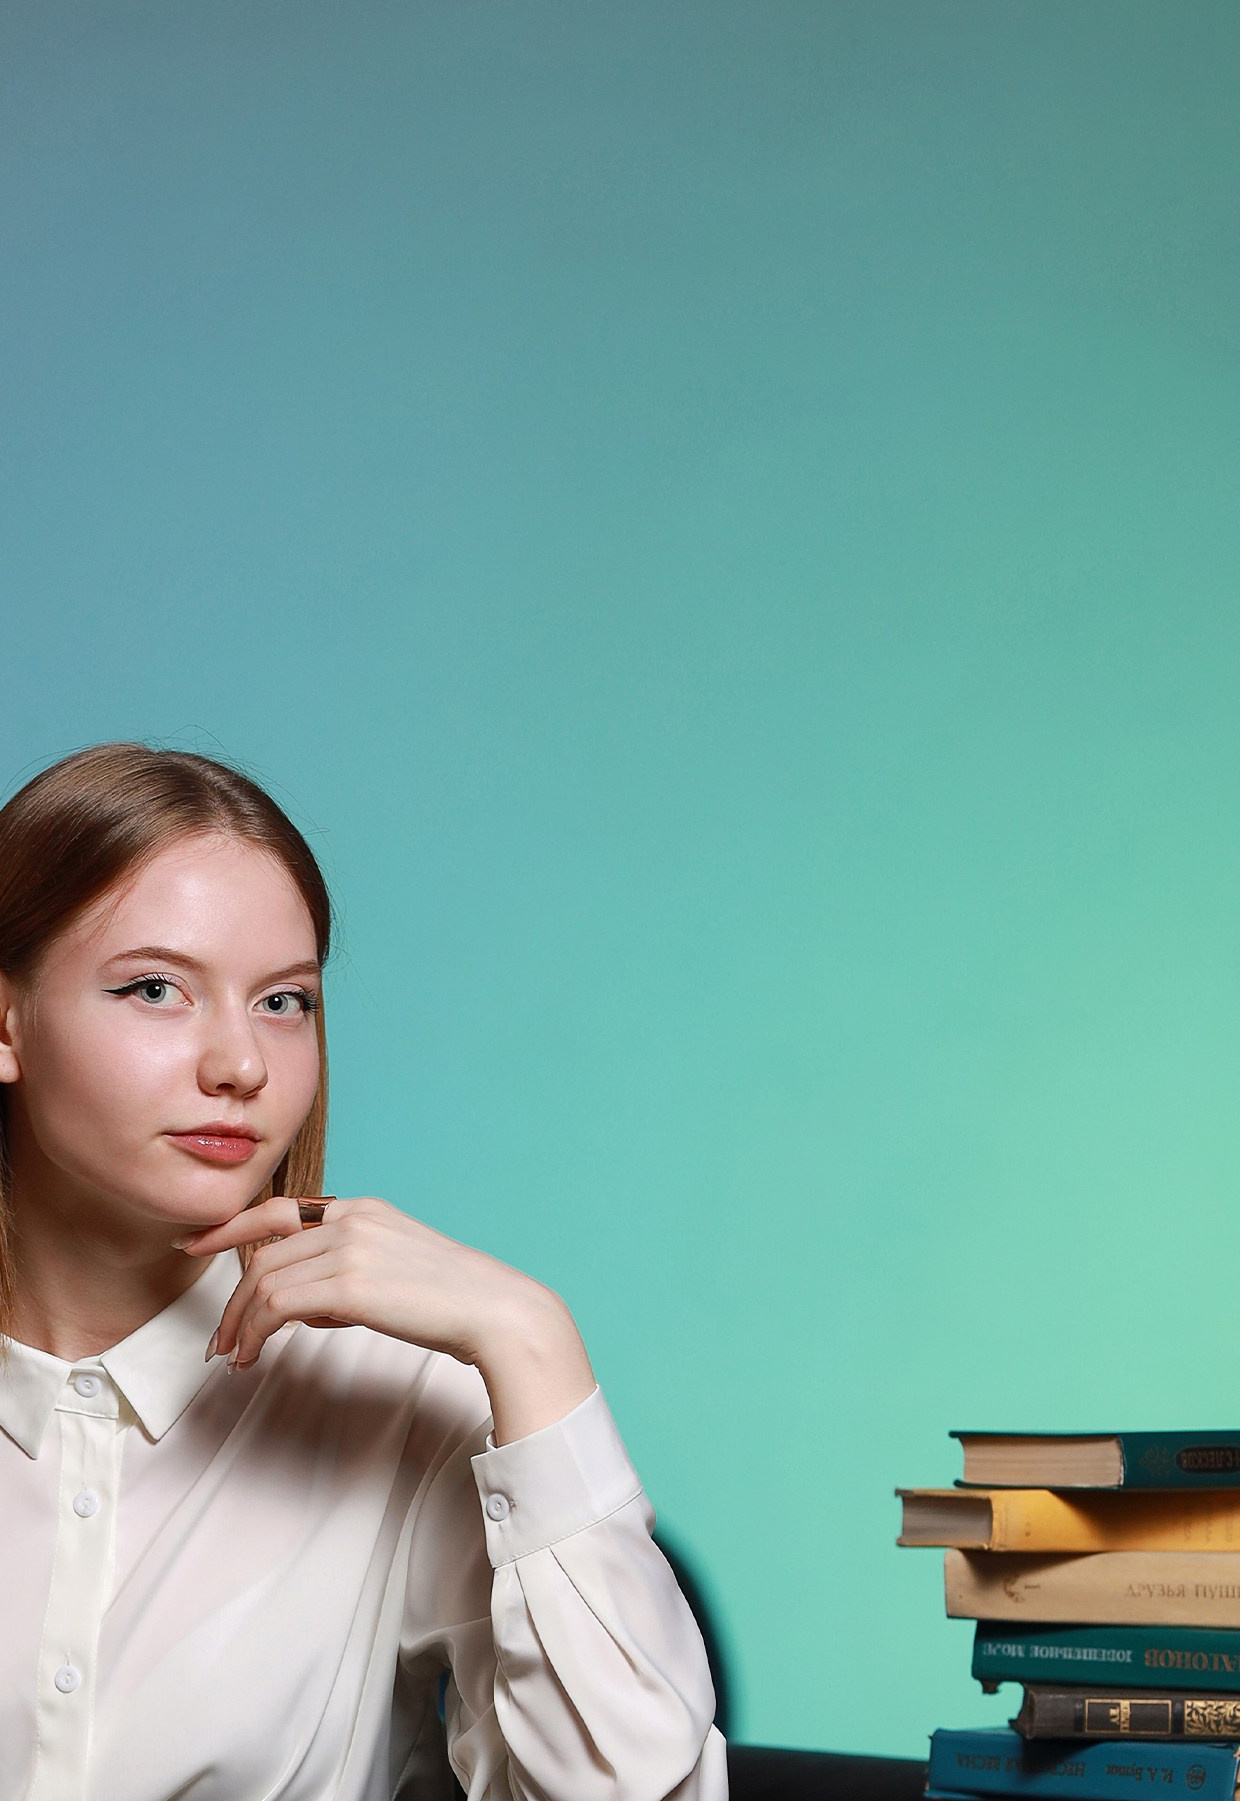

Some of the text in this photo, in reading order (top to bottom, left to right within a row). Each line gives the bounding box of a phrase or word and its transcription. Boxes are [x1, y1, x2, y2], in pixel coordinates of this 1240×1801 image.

[1124, 1583, 1240, 1600] ДРУЗЬЯ ПУШ
[1144, 1648, 1240, 1673] АТОНОВ
